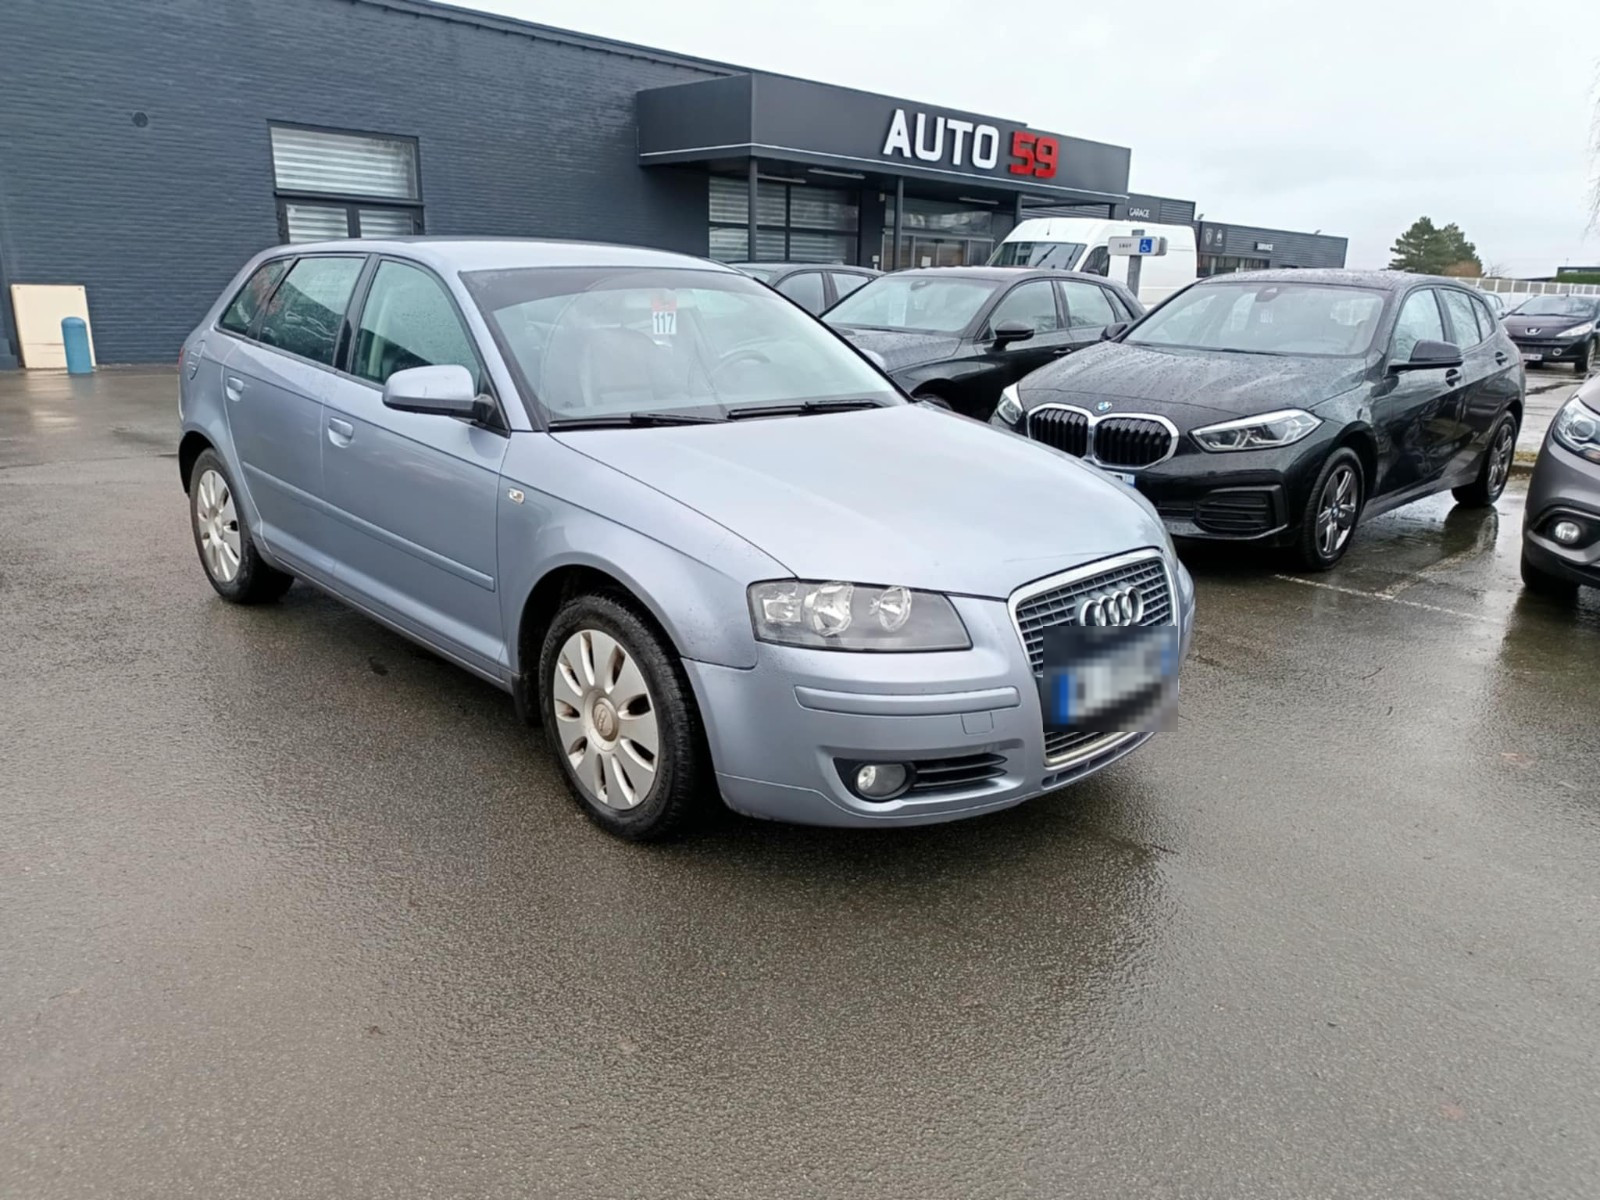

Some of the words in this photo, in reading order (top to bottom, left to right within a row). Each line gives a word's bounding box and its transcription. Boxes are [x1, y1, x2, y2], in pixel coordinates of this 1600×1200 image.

[883, 108, 999, 170] AUTO
[1009, 131, 1059, 178] 59
[654, 312, 675, 333] 117
